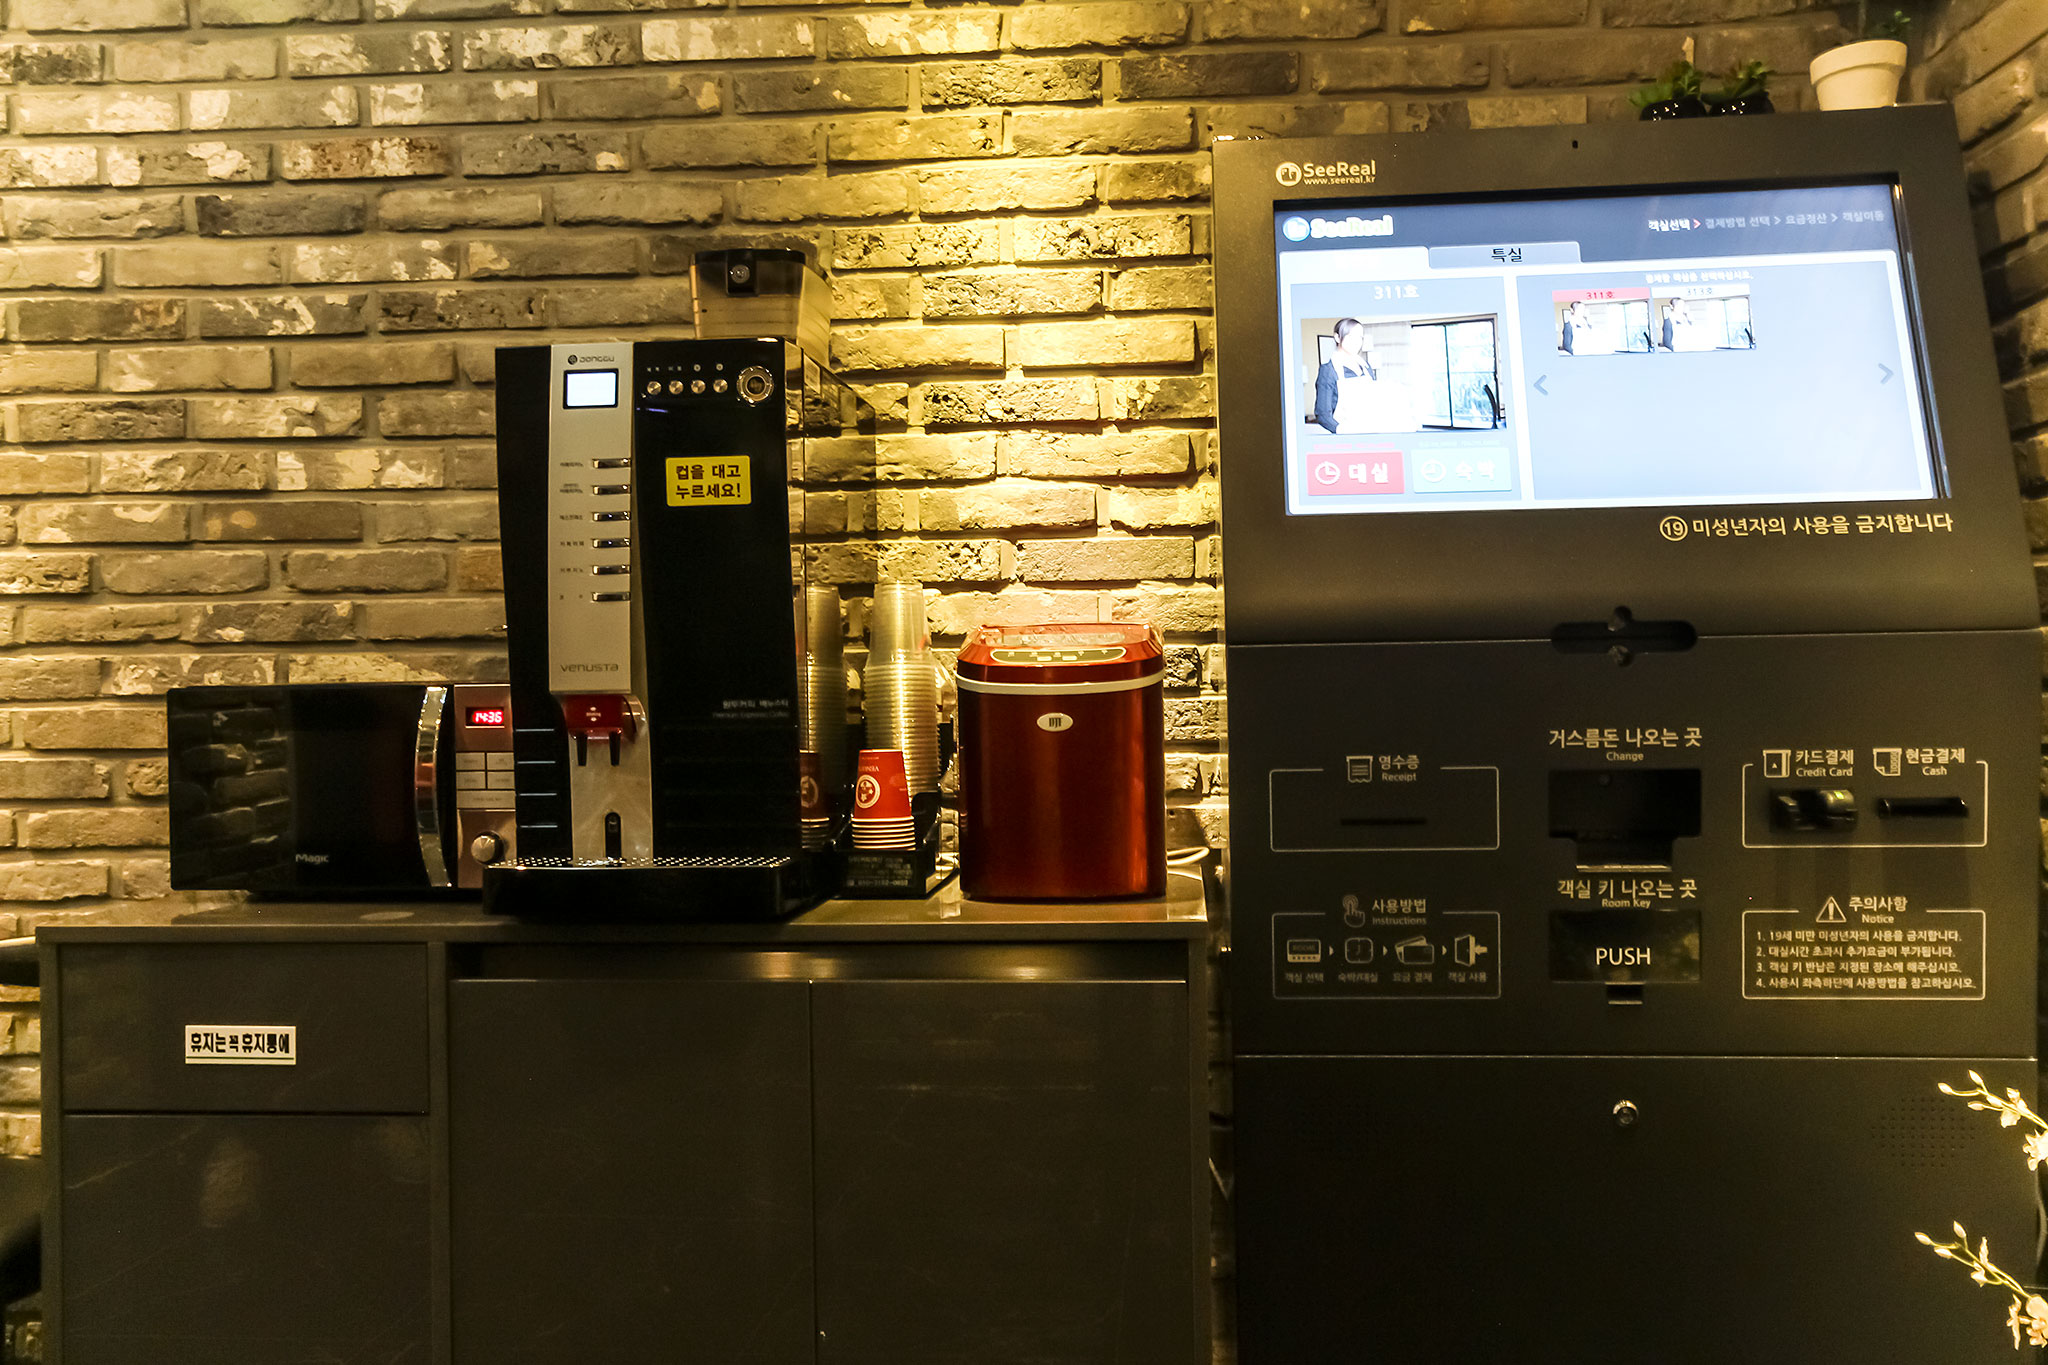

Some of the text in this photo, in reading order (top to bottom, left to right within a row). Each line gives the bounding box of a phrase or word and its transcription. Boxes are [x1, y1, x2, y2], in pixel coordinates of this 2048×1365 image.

[1303, 160, 1376, 177] SeeReal
[1304, 175, 1376, 185] www.seereal.kr
[1310, 214, 1394, 239] SeeReal
[1491, 247, 1523, 263] 특실
[1374, 284, 1420, 300] 311호
[676, 464, 741, 480] 컵을 대고
[1349, 462, 1389, 484] 대실
[675, 484, 741, 499] 누르세요!
[1692, 516, 1787, 537] 미성년자의
[1793, 515, 1850, 535] 사용을
[1856, 513, 1954, 534] 금지합니다
[1549, 727, 1703, 749] 거스름돈 나오는 곳
[1378, 754, 1420, 770] 영수증
[1606, 751, 1644, 762] Change
[1796, 749, 1854, 765] 카드결제
[1905, 748, 1965, 764] 현금결제
[1381, 772, 1417, 783] Receipt
[1796, 766, 1853, 777] Credit Card
[1922, 766, 1948, 776] Cash
[295, 854, 329, 865] Magic
[1557, 879, 1698, 899] 객실 키 나오는 곳
[1371, 899, 1427, 914] 사용방법
[1602, 899, 1651, 909] Room Key
[1849, 896, 1908, 912] 주의사항
[1372, 915, 1427, 926] Instructions
[1861, 914, 1895, 924] Notice
[1757, 930, 1766, 942] 1.
[1769, 930, 1792, 942] 19세
[1795, 930, 1816, 942] 미만
[1818, 930, 1869, 942] 미성년자의
[1872, 930, 1903, 942] 사용을
[1596, 947, 1651, 965] PUSH
[1756, 946, 1766, 958] 2.
[1756, 962, 1766, 973] 3.
[1769, 962, 1789, 973] 객실
[1792, 962, 1802, 973] 키
[1756, 977, 1766, 989] 4.
[190, 1032, 290, 1054] 휴지는 꼭 휴지통에
